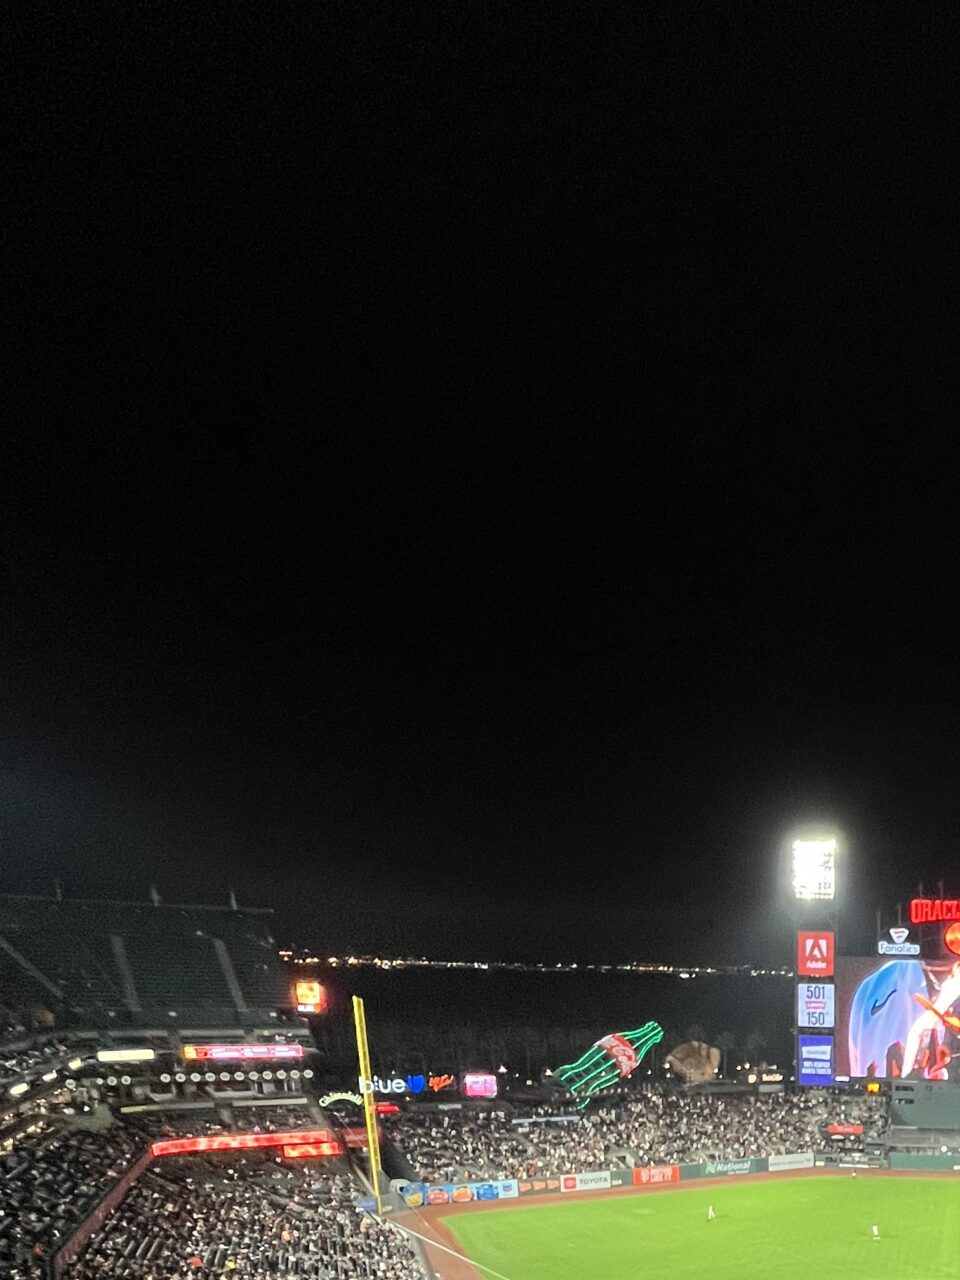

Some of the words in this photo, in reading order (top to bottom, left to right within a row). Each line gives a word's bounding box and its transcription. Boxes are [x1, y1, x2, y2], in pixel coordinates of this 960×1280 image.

[879, 942, 919, 954] Fanatics
[806, 960, 827, 969] Adobe
[806, 985, 826, 999] 501
[806, 1011, 826, 1026] 150
[716, 1160, 751, 1172] National
[579, 1176, 609, 1187] TOYOTA
